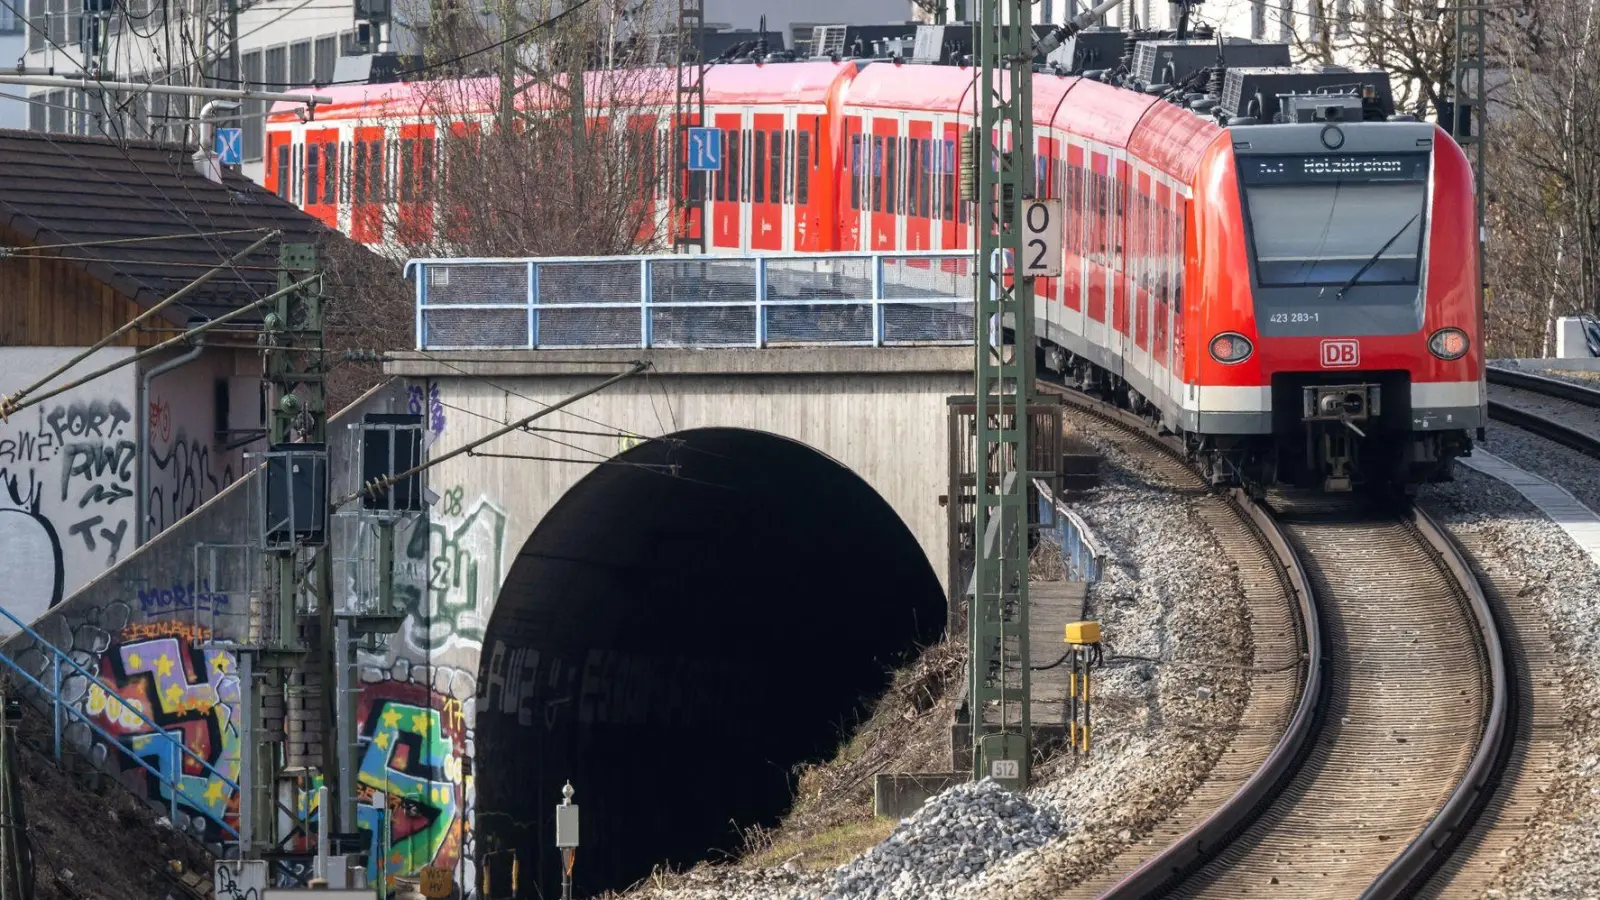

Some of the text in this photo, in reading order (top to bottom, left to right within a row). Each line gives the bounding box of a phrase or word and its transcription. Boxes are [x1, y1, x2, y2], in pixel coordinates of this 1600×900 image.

[1269, 312, 1320, 323] 423 283-1
[1323, 342, 1357, 365] DB
[995, 762, 1015, 777] 512
